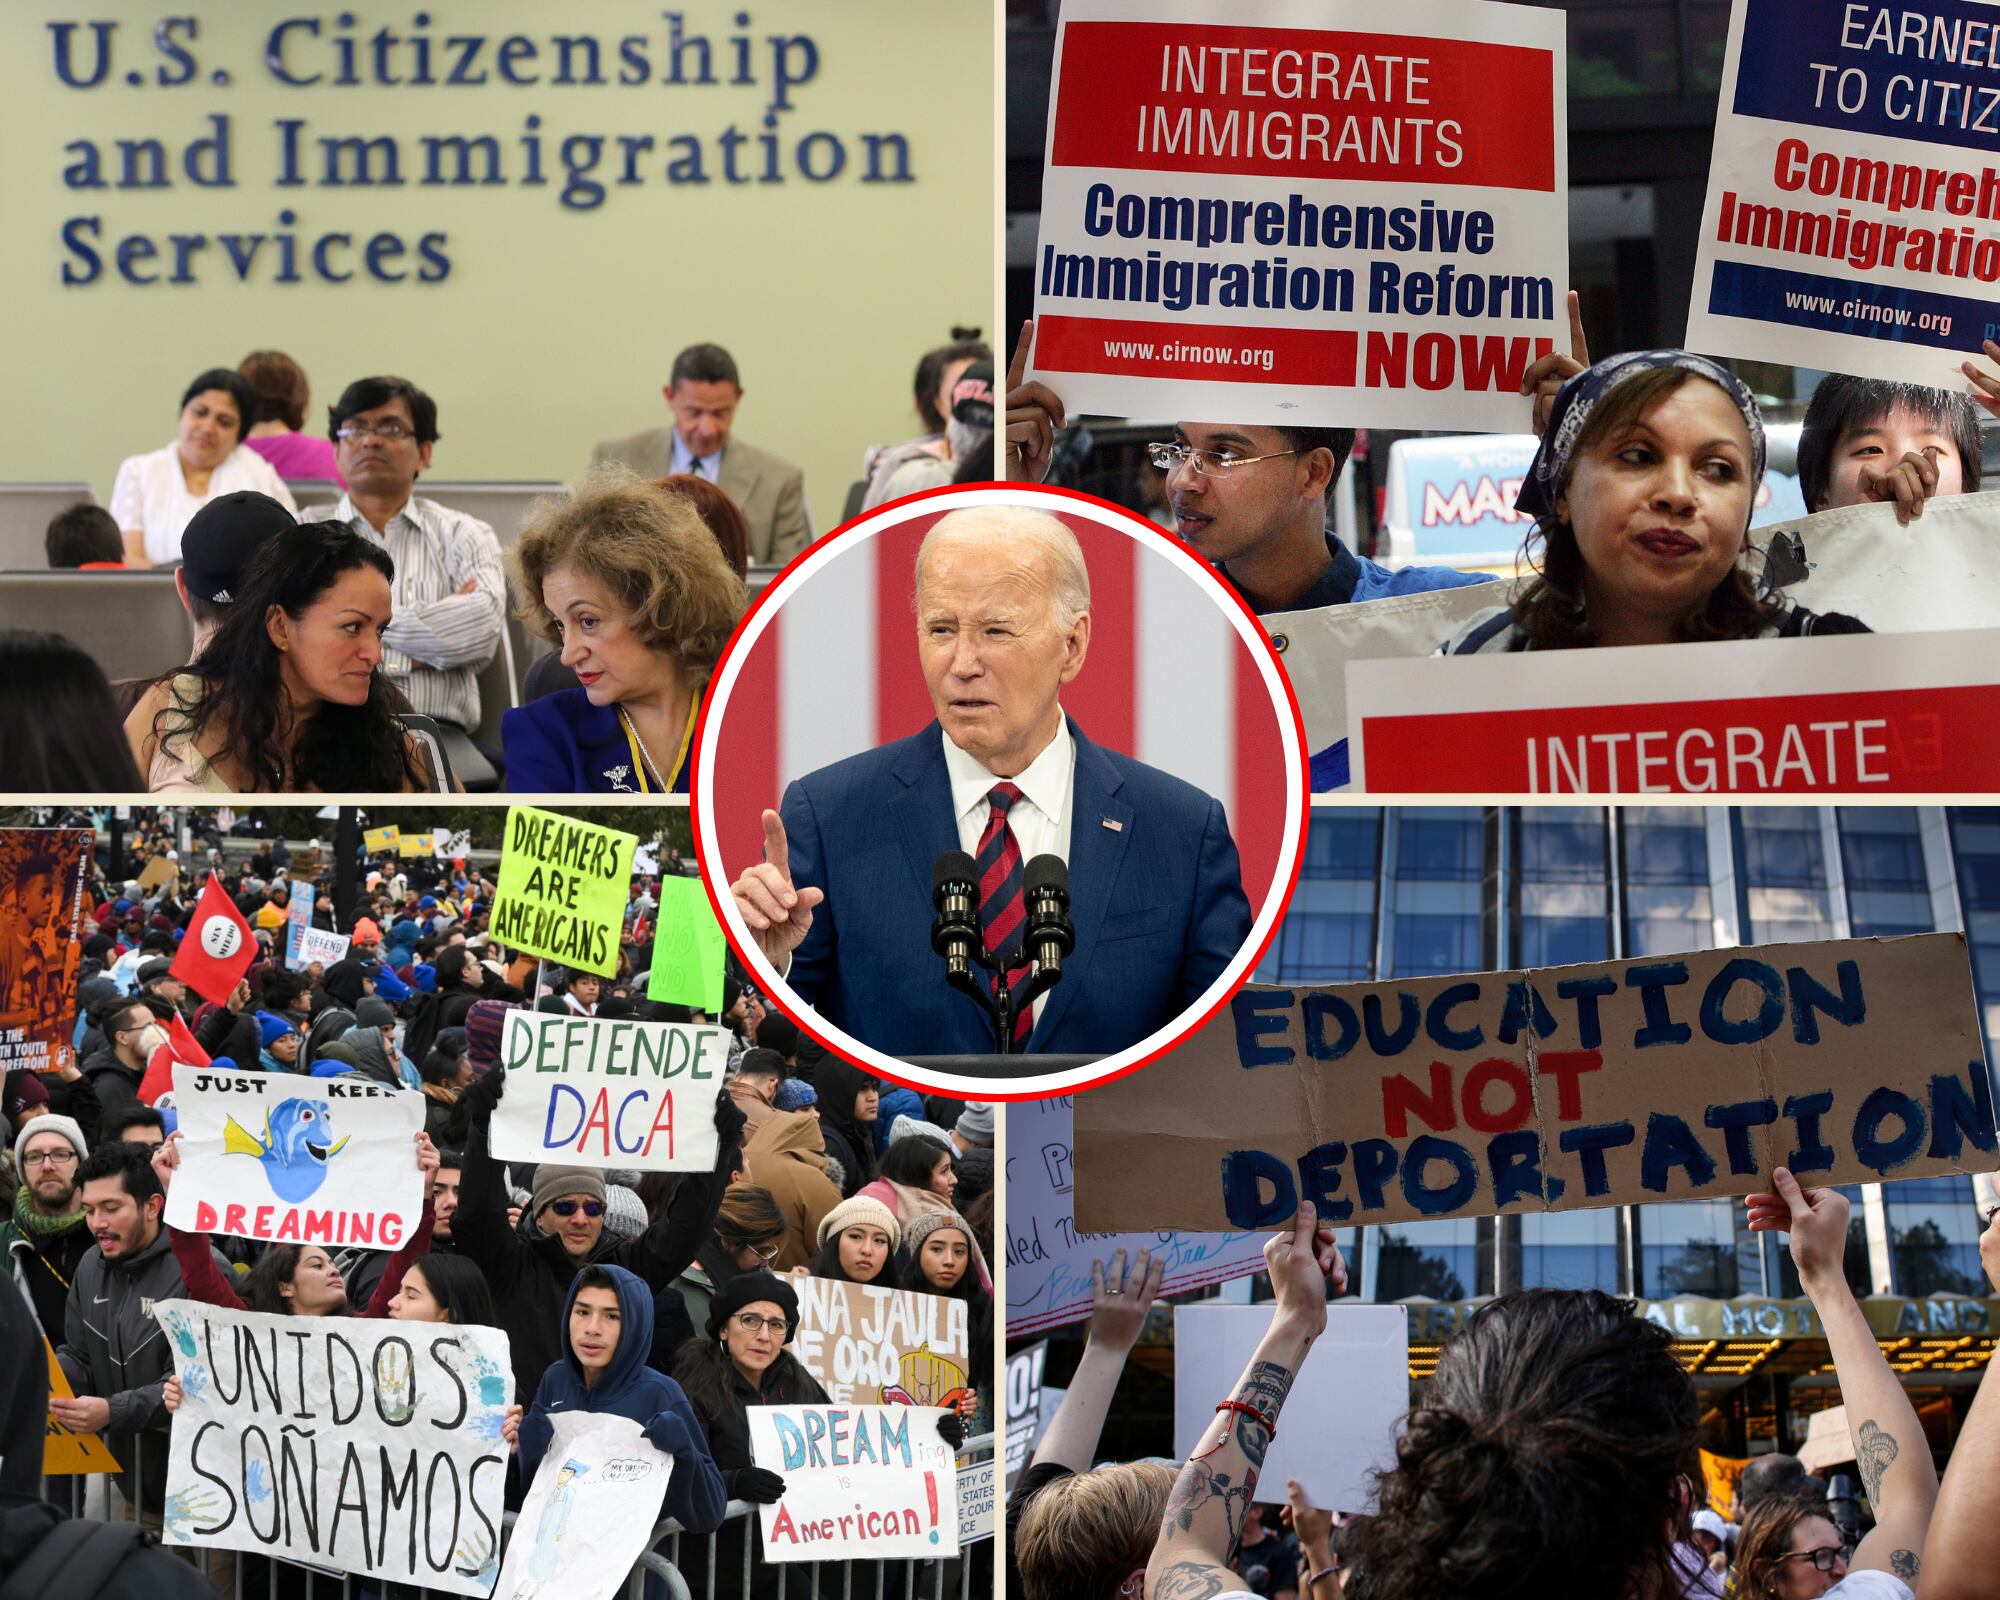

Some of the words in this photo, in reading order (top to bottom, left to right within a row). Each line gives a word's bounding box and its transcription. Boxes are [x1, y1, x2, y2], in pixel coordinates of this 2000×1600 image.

[48, 17, 231, 89] U.S.
[264, 12, 820, 110] Citizenship
[1161, 44, 1430, 104] INTEGRATE
[1810, 62, 1868, 114] TO
[1885, 74, 2000, 134] CITIZ
[62, 115, 236, 190] and
[275, 114, 916, 210] Immigration
[1137, 105, 1463, 168] IMMIGRANTS
[1773, 138, 2000, 221] Compreh
[61, 210, 453, 286] Services
[1084, 183, 1495, 255] Comprehensive
[1716, 191, 2000, 283] Immigratio
[1041, 244, 1354, 312] Immigration
[1368, 261, 1554, 321] Reform
[1786, 290, 1952, 336] www.cirnow.org
[1103, 339, 1275, 371] www.cirnow.org
[1526, 718, 1889, 794] INTEGRATE
[78, 854, 87, 877] PLAN
[512, 815, 623, 879] DREAMERS
[73, 879, 84, 921] STRATEGIC
[524, 866, 581, 909] ARE
[211, 925, 222, 944] SIN
[219, 924, 236, 957] MIEDO
[308, 936, 342, 953] DEFEND
[494, 897, 609, 968] AMERICANS
[1233, 958, 1867, 1070] EDUCATION
[14, 1041, 48, 1057] YOUTH
[507, 1017, 719, 1080] DEFIENDE
[194, 1074, 267, 1094] JUST
[1381, 1050, 1603, 1138] NOT
[543, 1083, 674, 1160] DACA
[1222, 1059, 1999, 1230] DEPORTATION
[195, 1200, 403, 1245] DREAMING
[860, 1285, 969, 1359] JAULA
[1898, 1301, 1990, 1334] AND
[204, 1319, 468, 1430] UNIDOS
[834, 1334, 900, 1387] ORO
[191, 1421, 503, 1577] SOÑAMOS
[963, 1485, 994, 1504] STATES
[981, 1470, 993, 1483] OF
